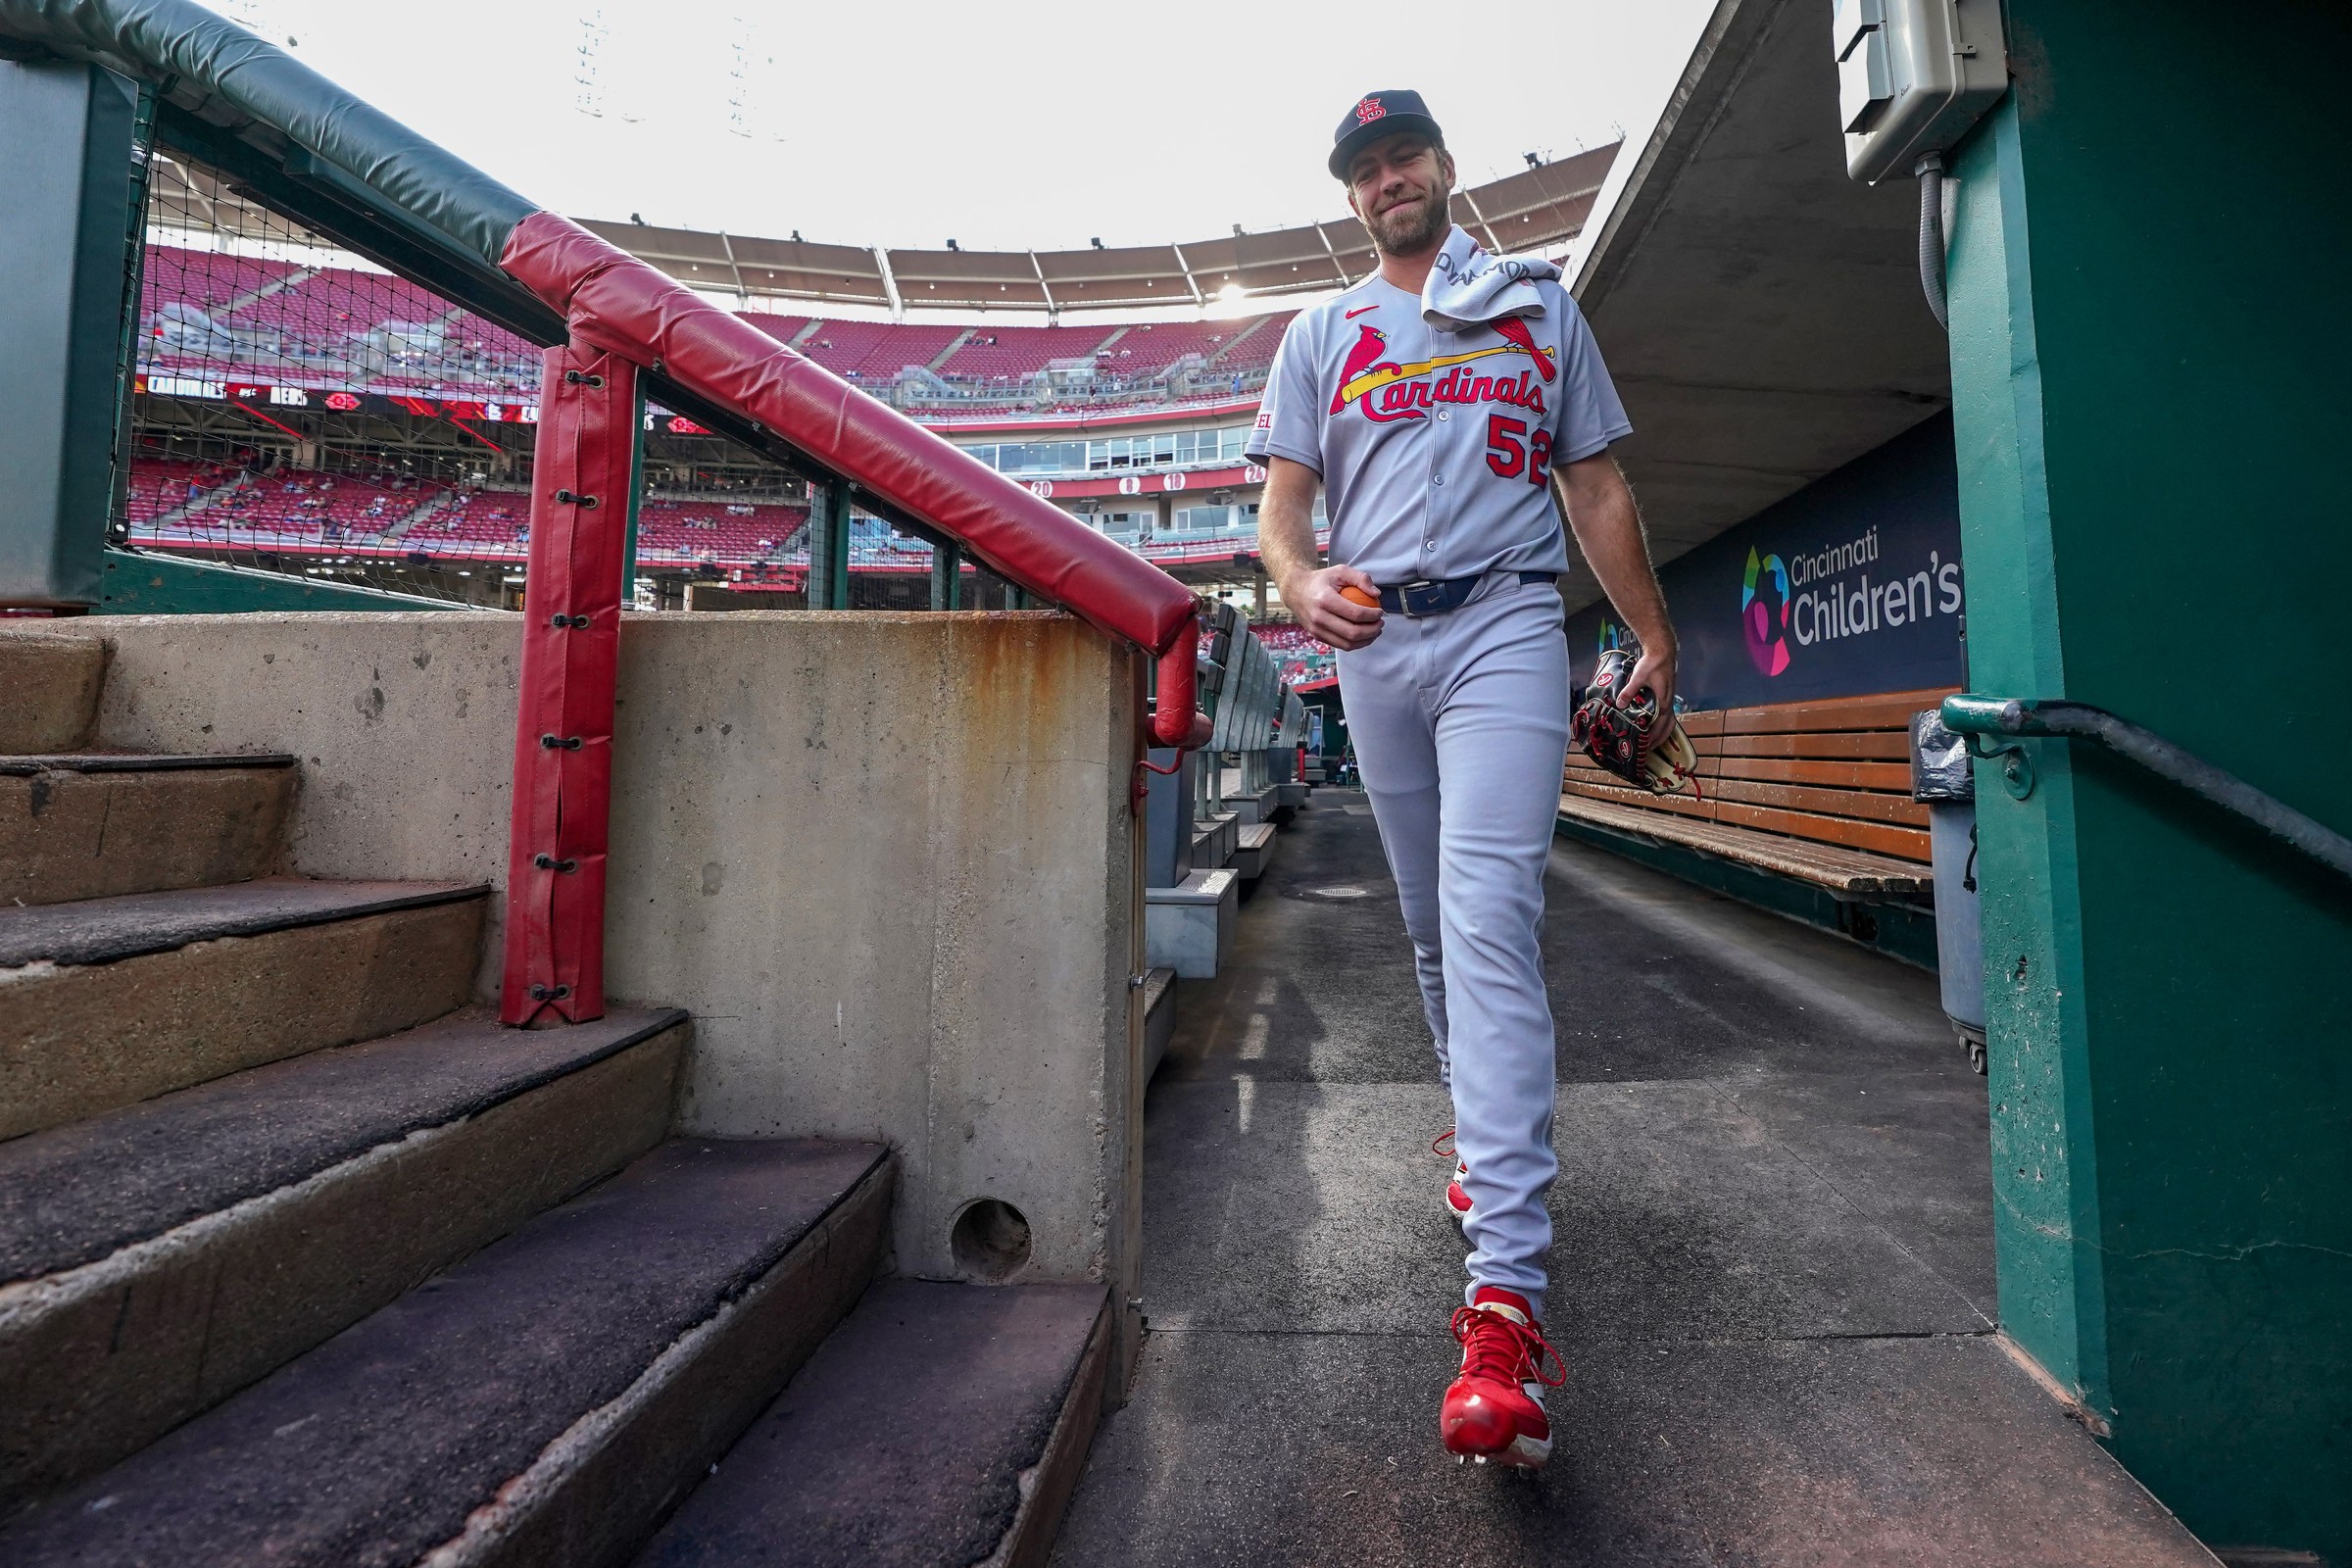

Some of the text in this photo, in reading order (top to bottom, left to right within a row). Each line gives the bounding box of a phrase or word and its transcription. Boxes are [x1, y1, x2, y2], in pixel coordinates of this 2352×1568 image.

[1360, 363, 1547, 423] Cardinals
[1486, 413, 1553, 491] 52
[1791, 524, 1880, 587] Cincinnati
